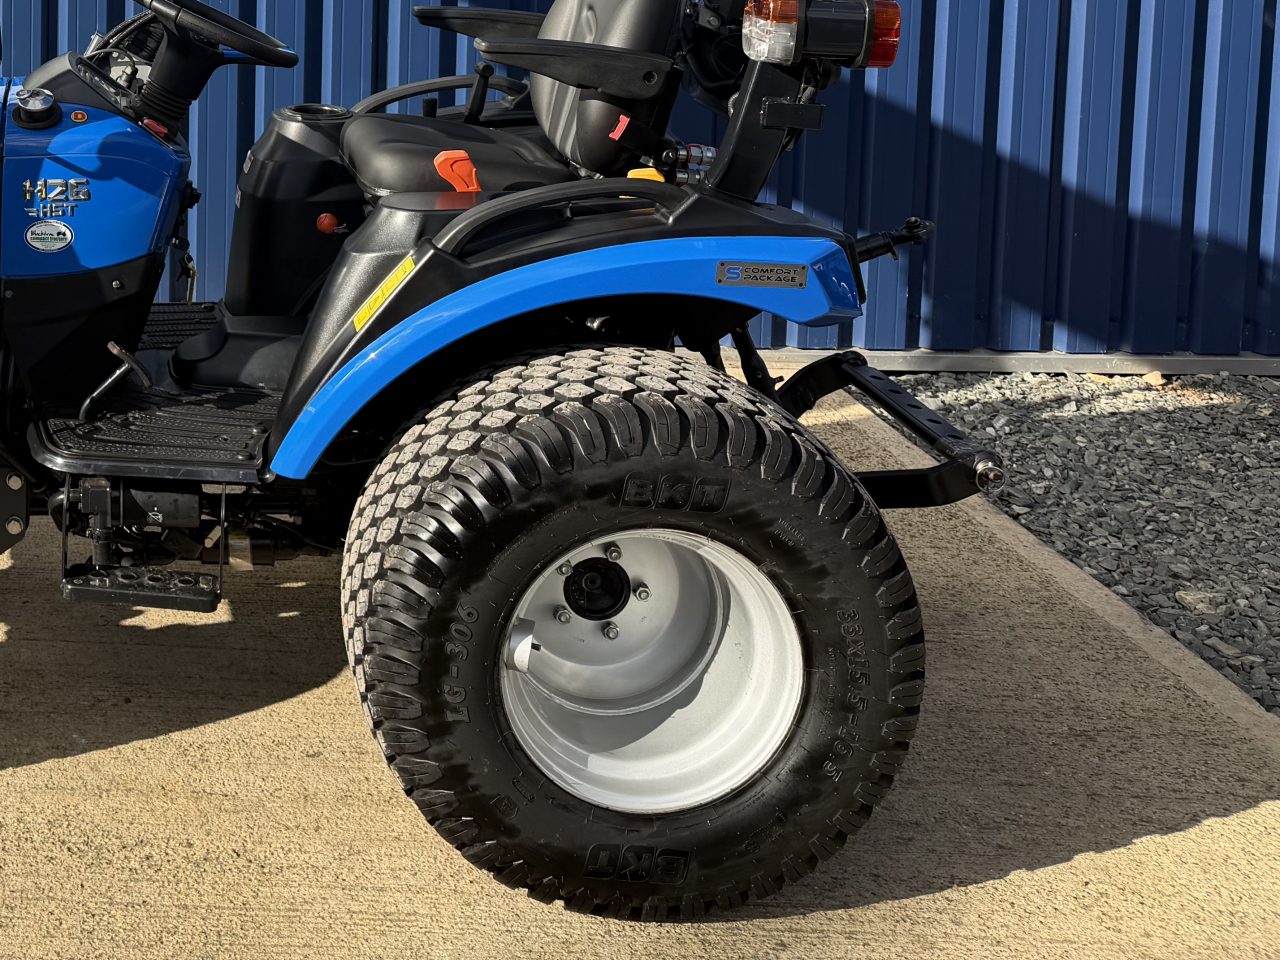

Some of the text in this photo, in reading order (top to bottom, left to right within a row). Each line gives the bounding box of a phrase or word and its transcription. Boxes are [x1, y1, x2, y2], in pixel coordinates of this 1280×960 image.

[744, 267, 799, 276] COMFORT
[743, 274, 798, 283] PACKAGE
[441, 600, 480, 724] LG-306
